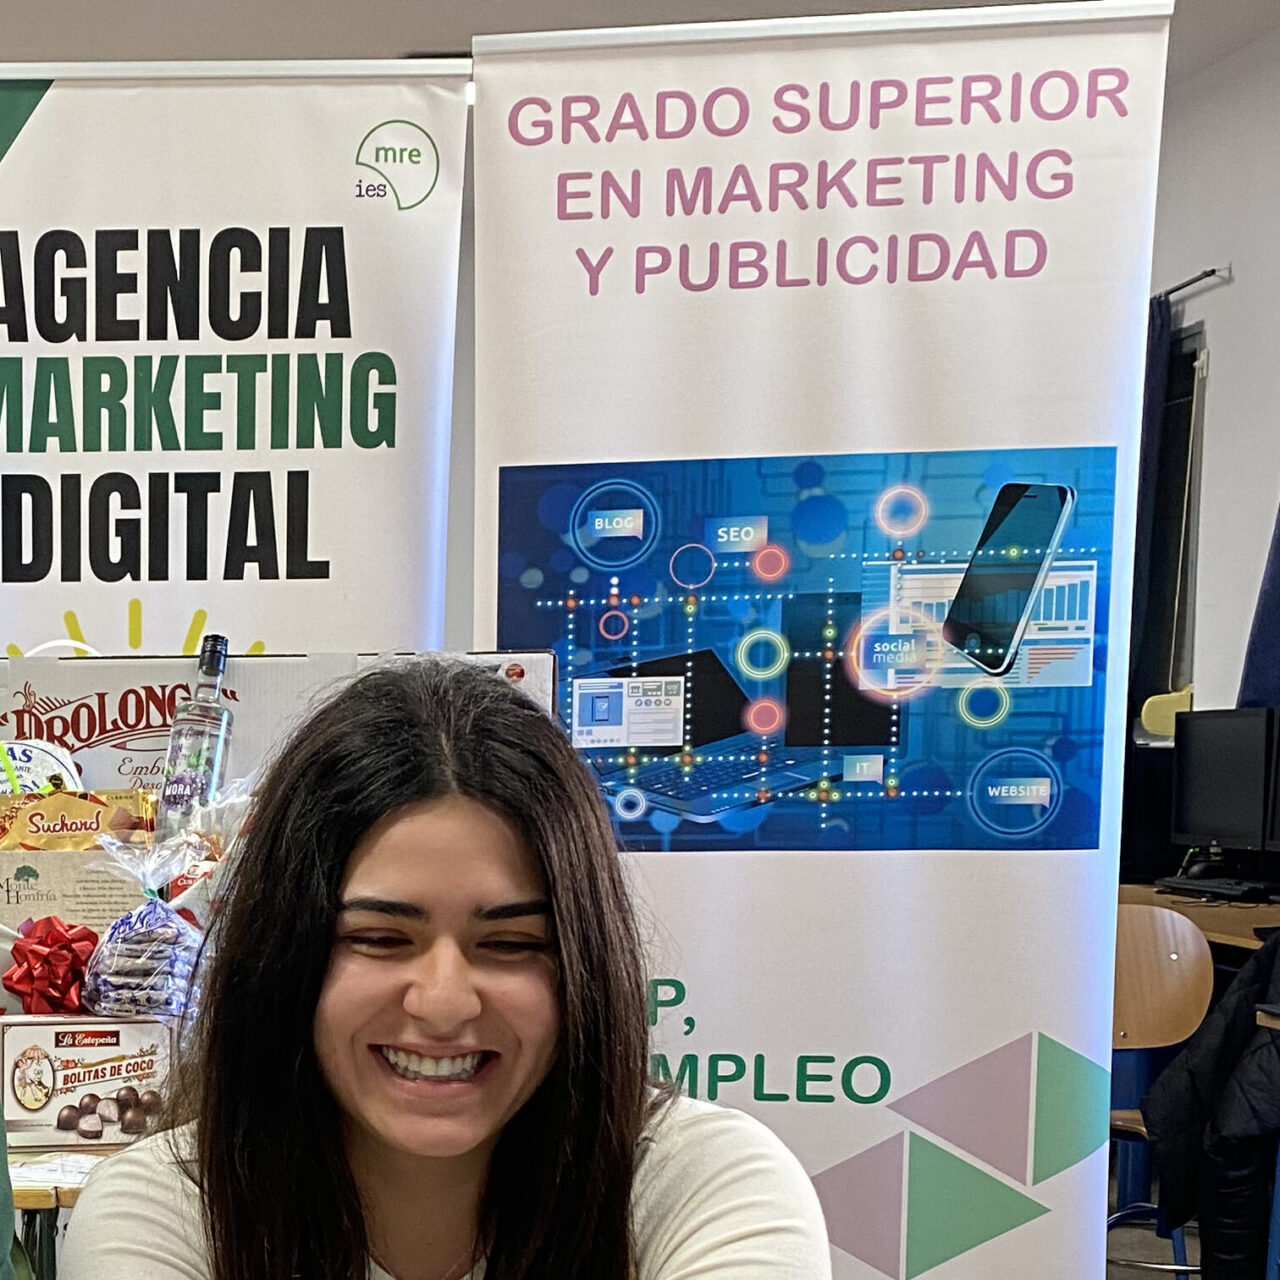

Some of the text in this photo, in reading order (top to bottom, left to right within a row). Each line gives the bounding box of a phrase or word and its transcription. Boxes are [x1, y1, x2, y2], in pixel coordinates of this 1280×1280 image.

[507, 67, 1131, 147] GRADO SUPERIOR
[375, 146, 422, 164] mre
[355, 179, 387, 198] ies
[556, 148, 1074, 221] EN MARKETING
[575, 229, 1048, 296] Y PUBLICIDAD
[1, 470, 330, 583] DIGITAL
[595, 517, 634, 530] BLOG
[717, 527, 755, 542] SEO
[874, 638, 916, 652] social
[872, 652, 917, 664] media
[856, 763, 869, 774] IT
[988, 785, 1047, 796] WEBSITE
[27, 810, 102, 834] Suchard
[647, 978, 696, 1036] P,
[63, 1059, 154, 1086] BOLITAS DE COCO
[649, 1053, 892, 1105] MPLEO
